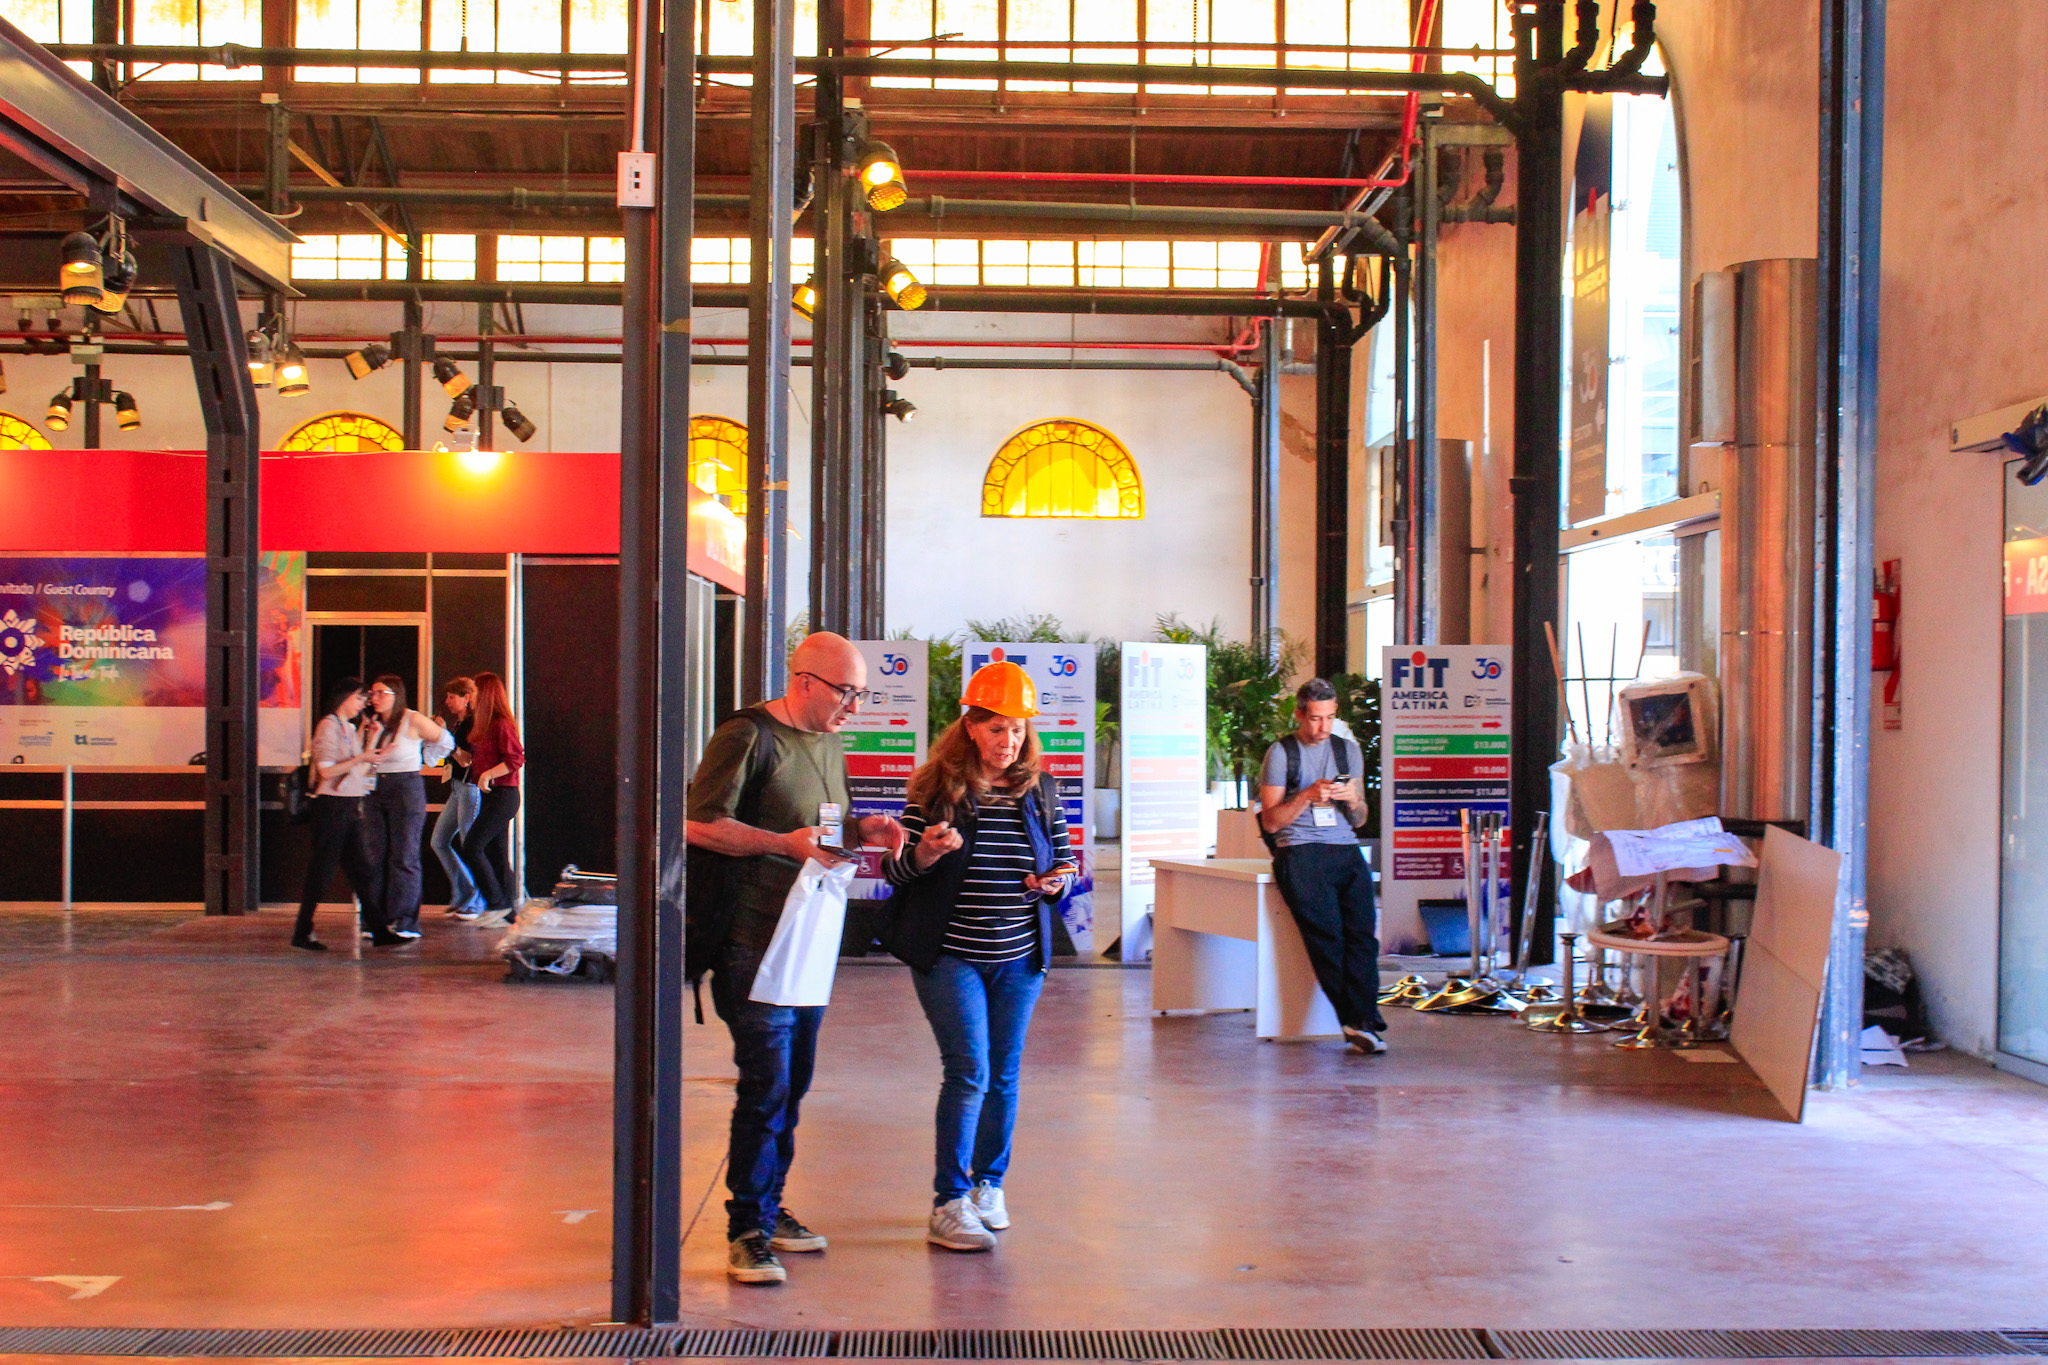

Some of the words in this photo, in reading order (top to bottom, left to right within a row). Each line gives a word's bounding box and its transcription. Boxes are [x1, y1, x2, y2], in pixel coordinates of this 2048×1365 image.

[43, 583, 73, 595] Guest
[74, 584, 117, 598] Country
[59, 625, 157, 645] República
[58, 643, 175, 660] Dominicana
[880, 654, 908, 675] 30
[1049, 655, 1077, 676] 30
[1472, 658, 1502, 679] 30
[1391, 691, 1449, 700] AMERICA
[1391, 701, 1449, 710] LATINA
